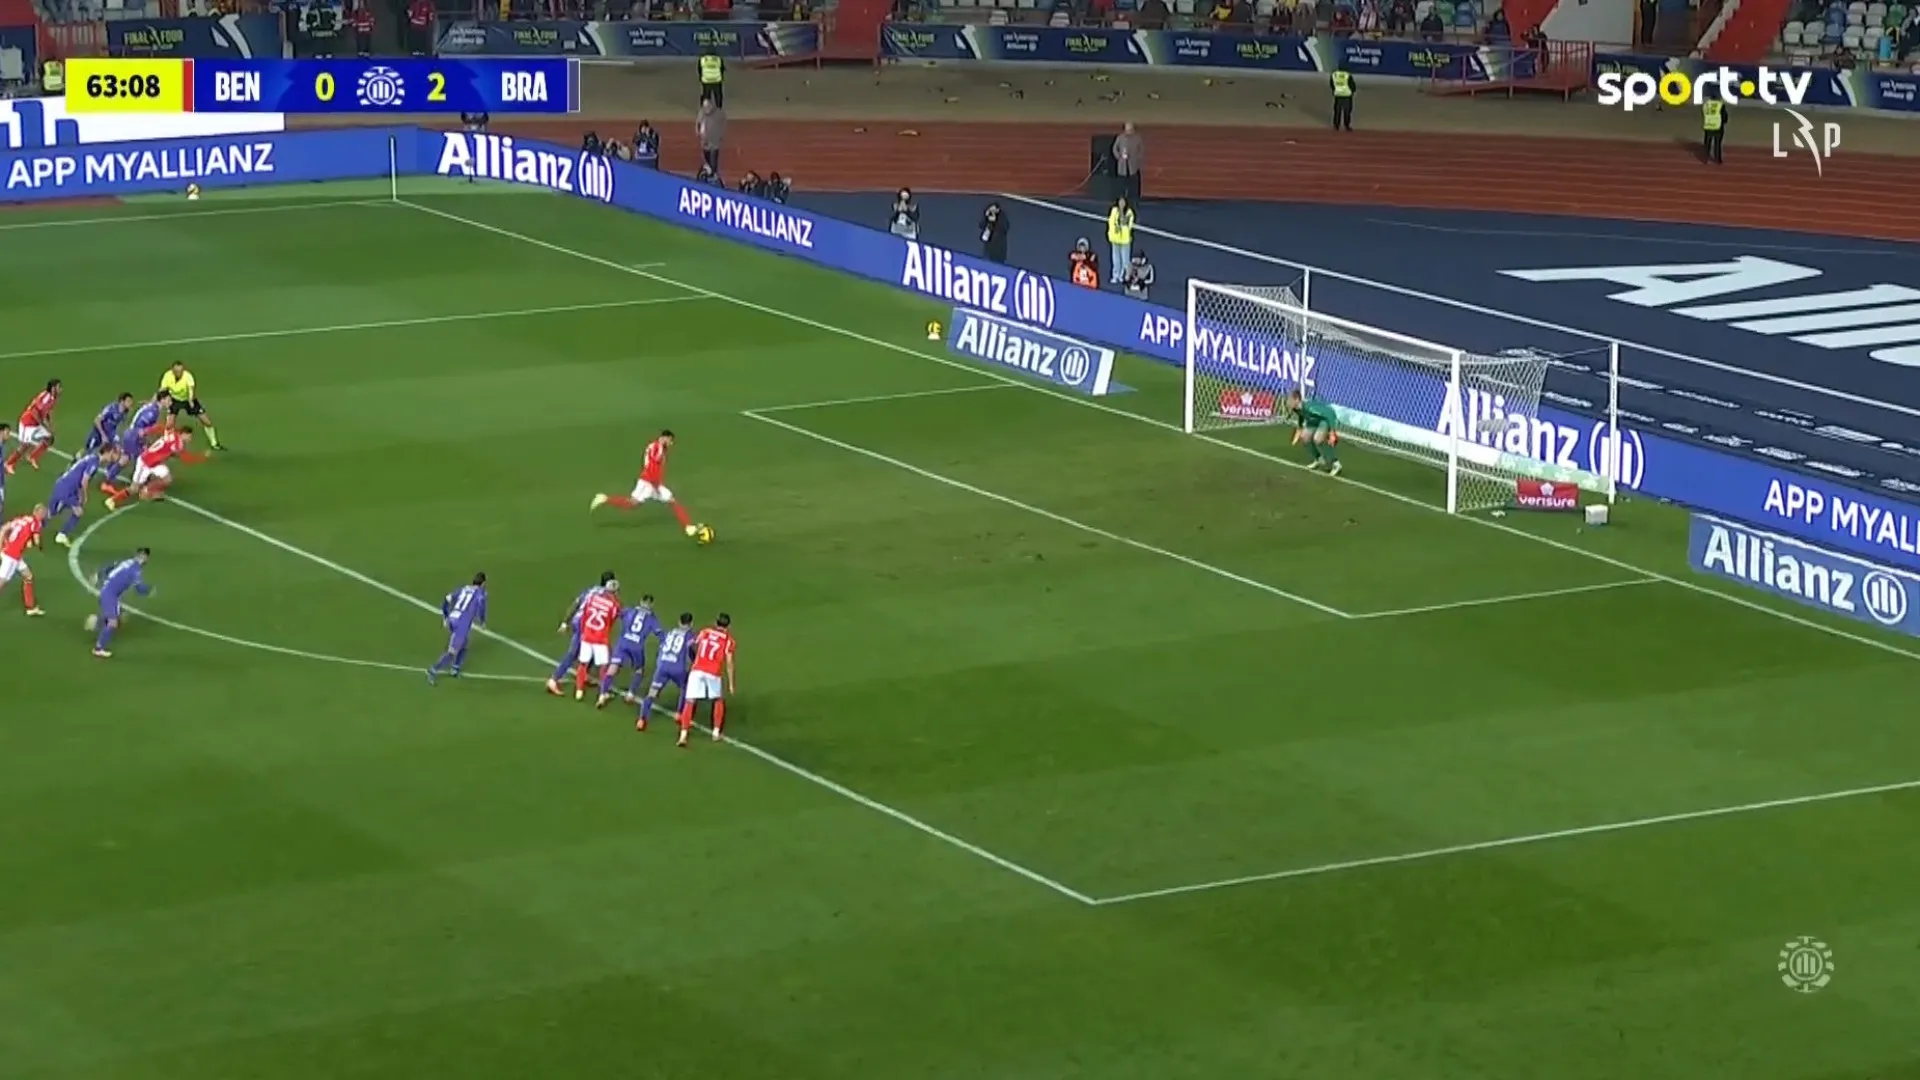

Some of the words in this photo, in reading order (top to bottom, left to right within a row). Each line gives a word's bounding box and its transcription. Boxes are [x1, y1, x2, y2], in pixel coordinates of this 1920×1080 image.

[7, 156, 76, 189] APP
[85, 142, 274, 184] MYALLIANZ
[437, 131, 573, 192] Allianz
[679, 186, 713, 219] APP
[715, 195, 814, 250] MYALLIANZ
[901, 241, 1007, 314] Allianz
[955, 315, 1058, 378] Allianz
[1140, 312, 1184, 347] APP
[1193, 329, 1316, 388] MYALLIANZ
[1220, 403, 1272, 418] verisure
[1436, 382, 1579, 470] Allianz
[1518, 495, 1577, 509] verisure
[1763, 478, 1824, 525] APP
[1704, 525, 1855, 613] Allianz
[585, 607, 609, 631] 25
[630, 613, 645, 633] 5
[699, 638, 721, 661] 17
